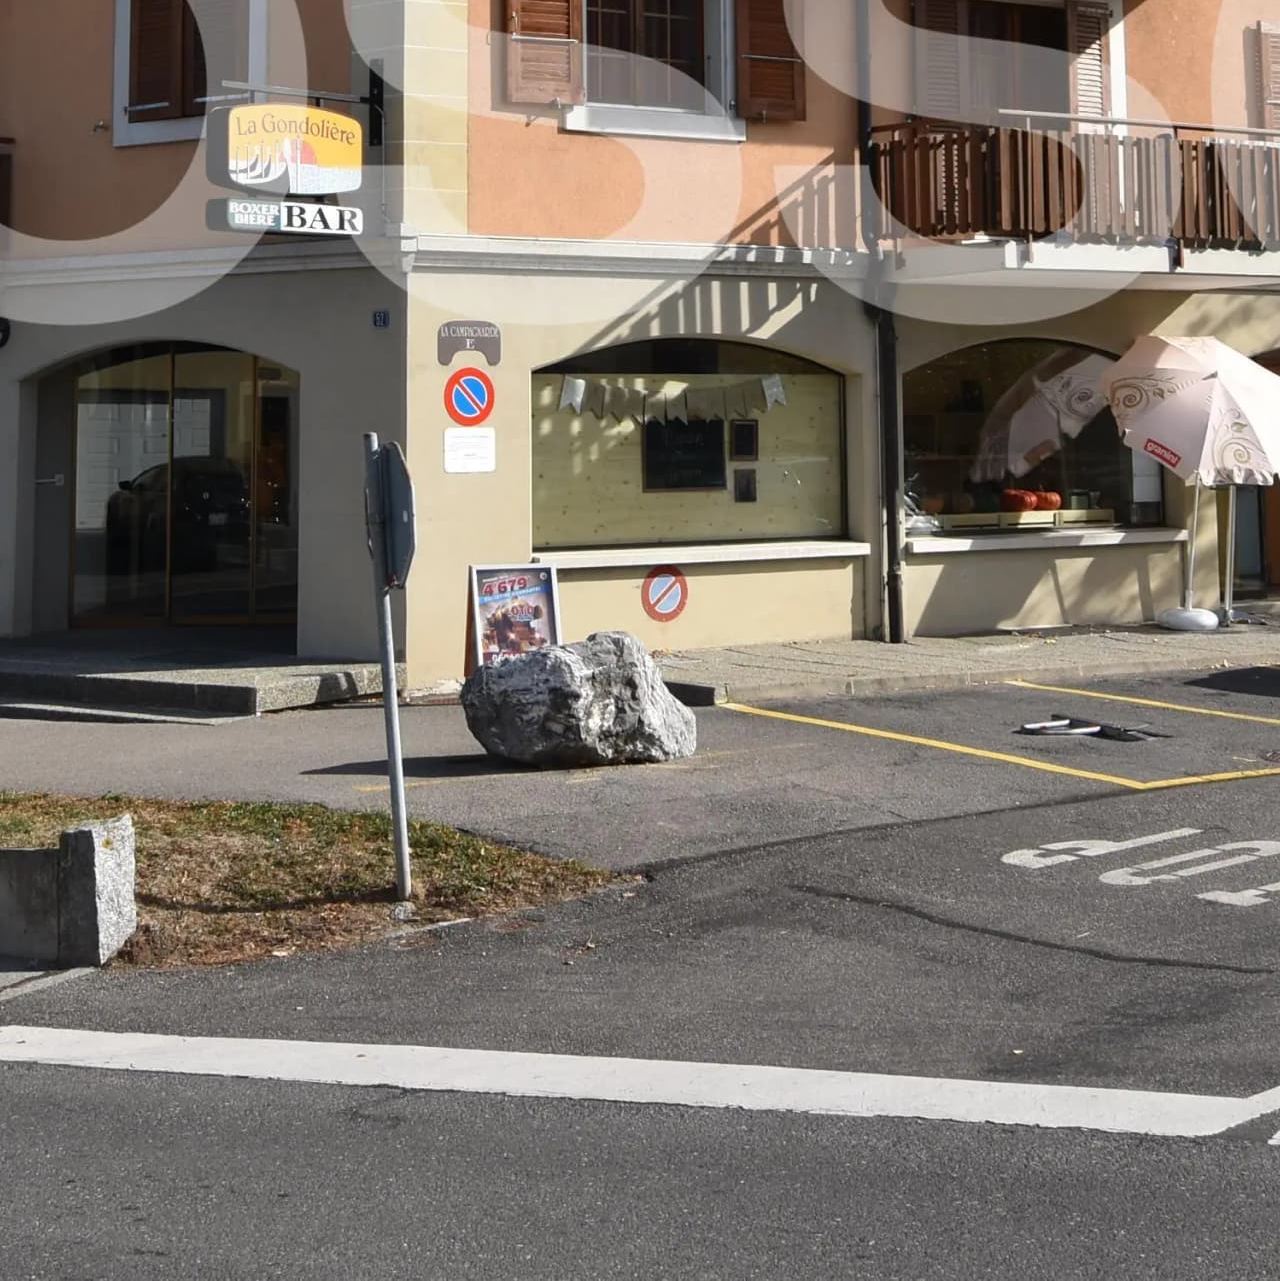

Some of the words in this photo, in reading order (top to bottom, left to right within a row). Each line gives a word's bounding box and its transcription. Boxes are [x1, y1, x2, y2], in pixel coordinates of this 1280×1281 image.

[236, 117, 257, 136] La
[261, 113, 355, 145] Gondolière
[230, 202, 279, 216] BOXER
[285, 205, 358, 232] BAR
[465, 338, 475, 349] E
[1145, 441, 1179, 465] granini
